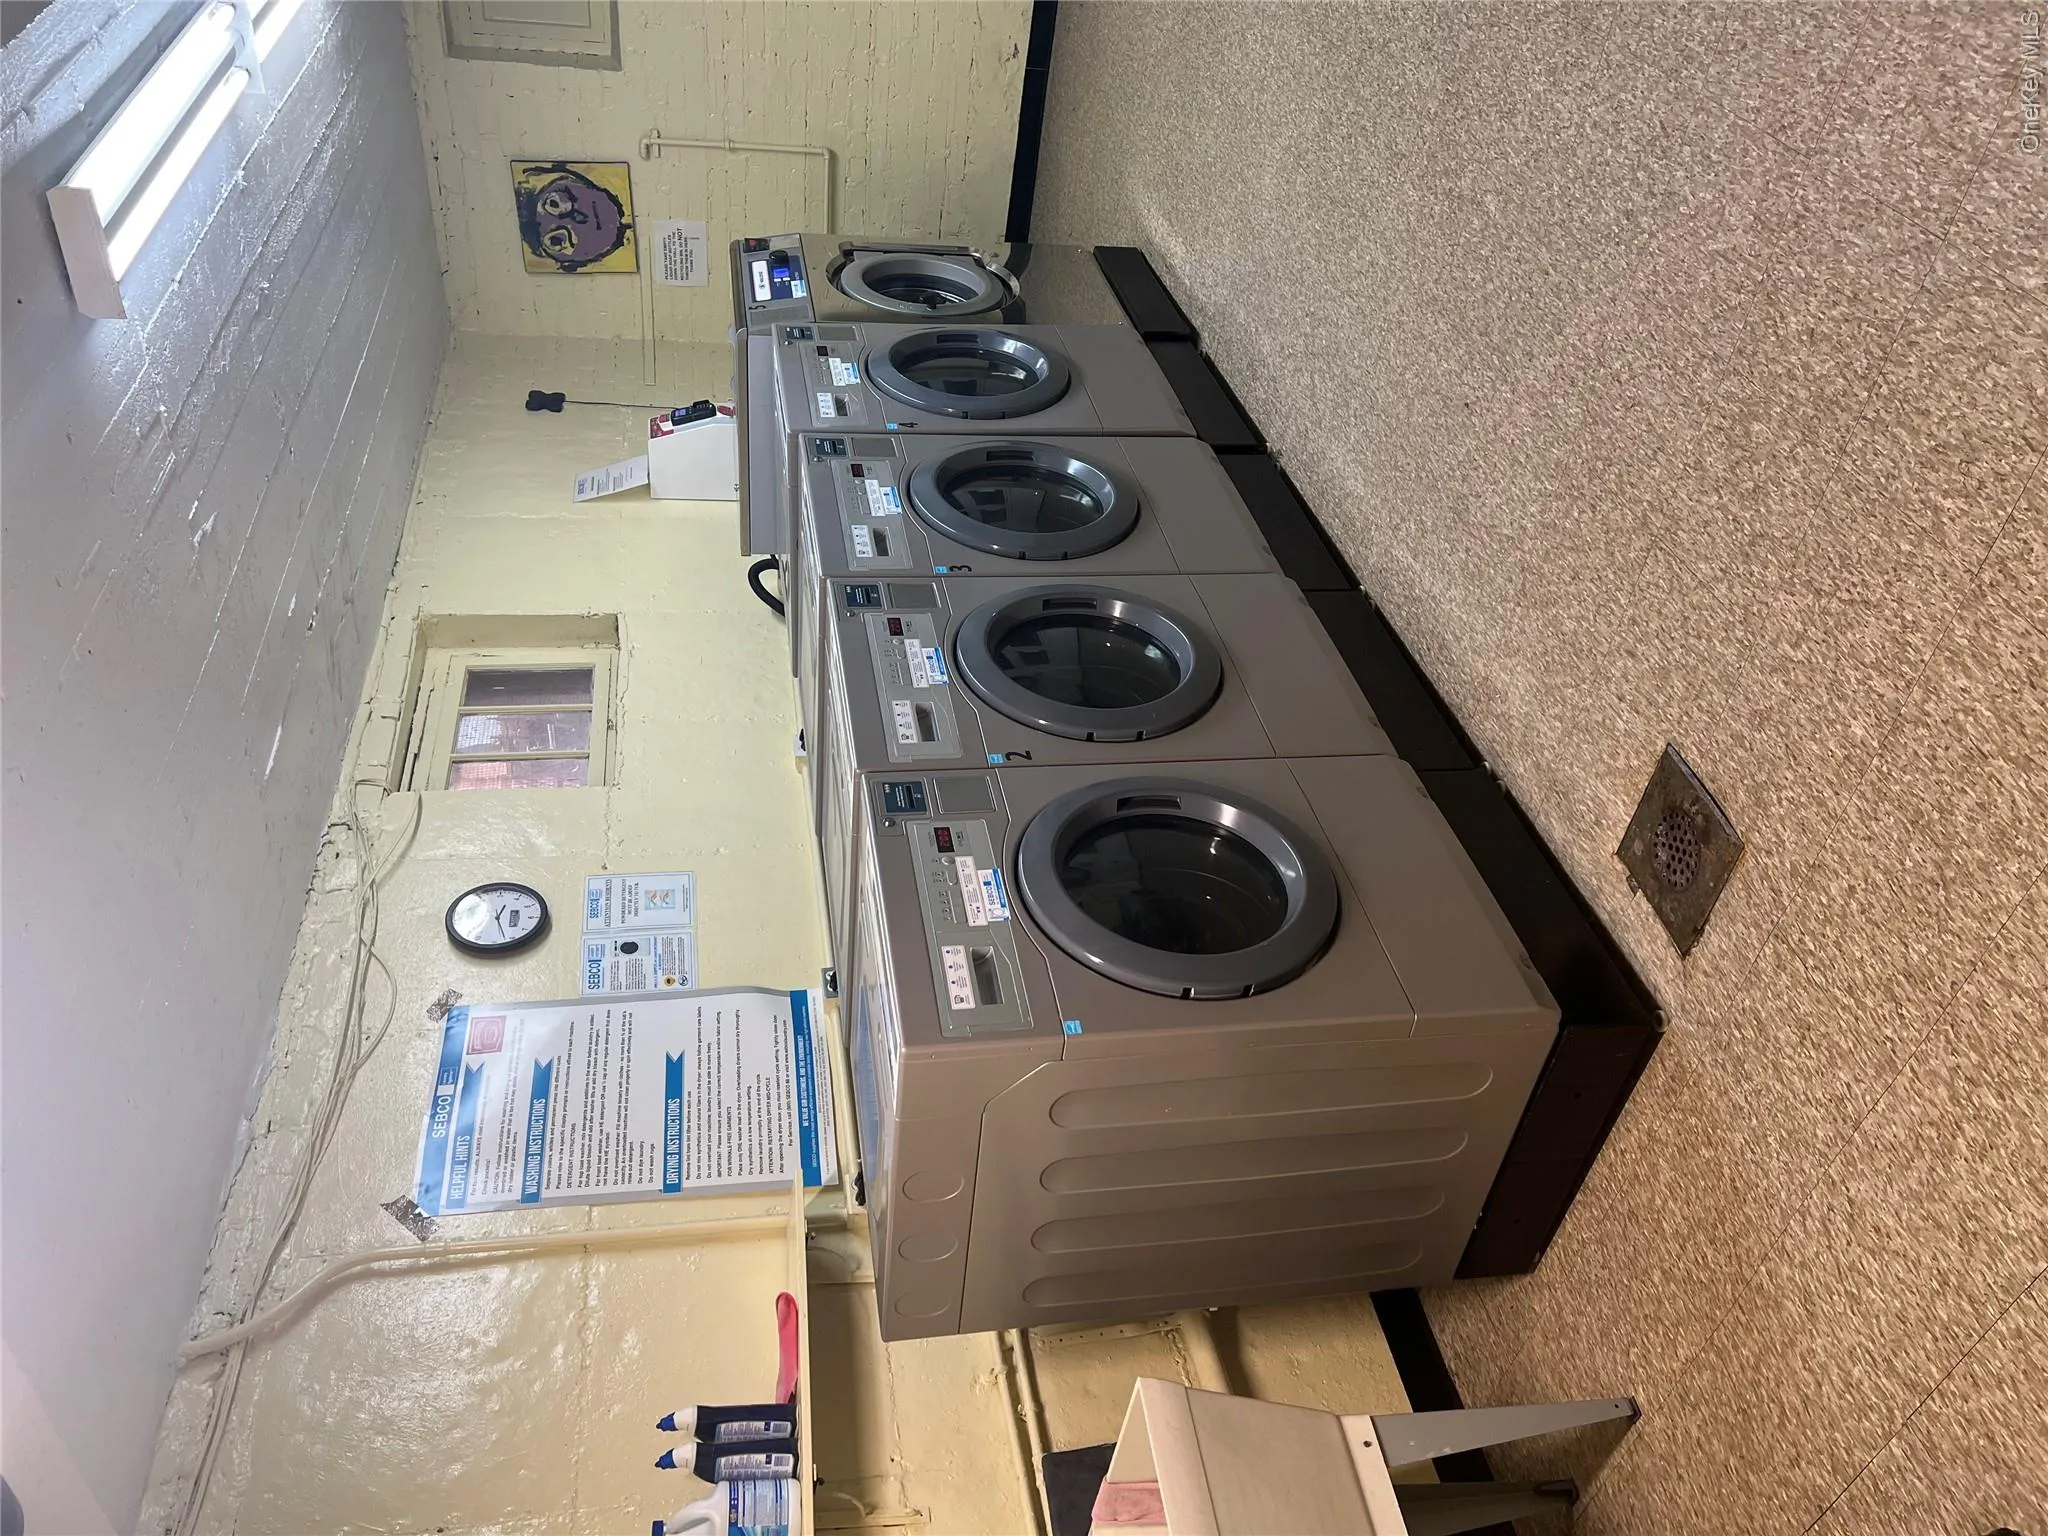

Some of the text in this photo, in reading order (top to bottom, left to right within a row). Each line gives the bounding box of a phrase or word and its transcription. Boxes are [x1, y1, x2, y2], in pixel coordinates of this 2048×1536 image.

[1005, 751, 1032, 761] 2
[589, 902, 599, 919] SEBCO
[986, 887, 995, 906] SEBCO
[588, 962, 600, 990] SEBCO
[431, 1096, 451, 1138] SEBCO
[524, 1098, 546, 1194] WASHING INSTRUCTIONS
[666, 1098, 680, 1184] DRYING INSTRUCTIONS
[450, 1136, 470, 1199] HELPFUL HINTS
